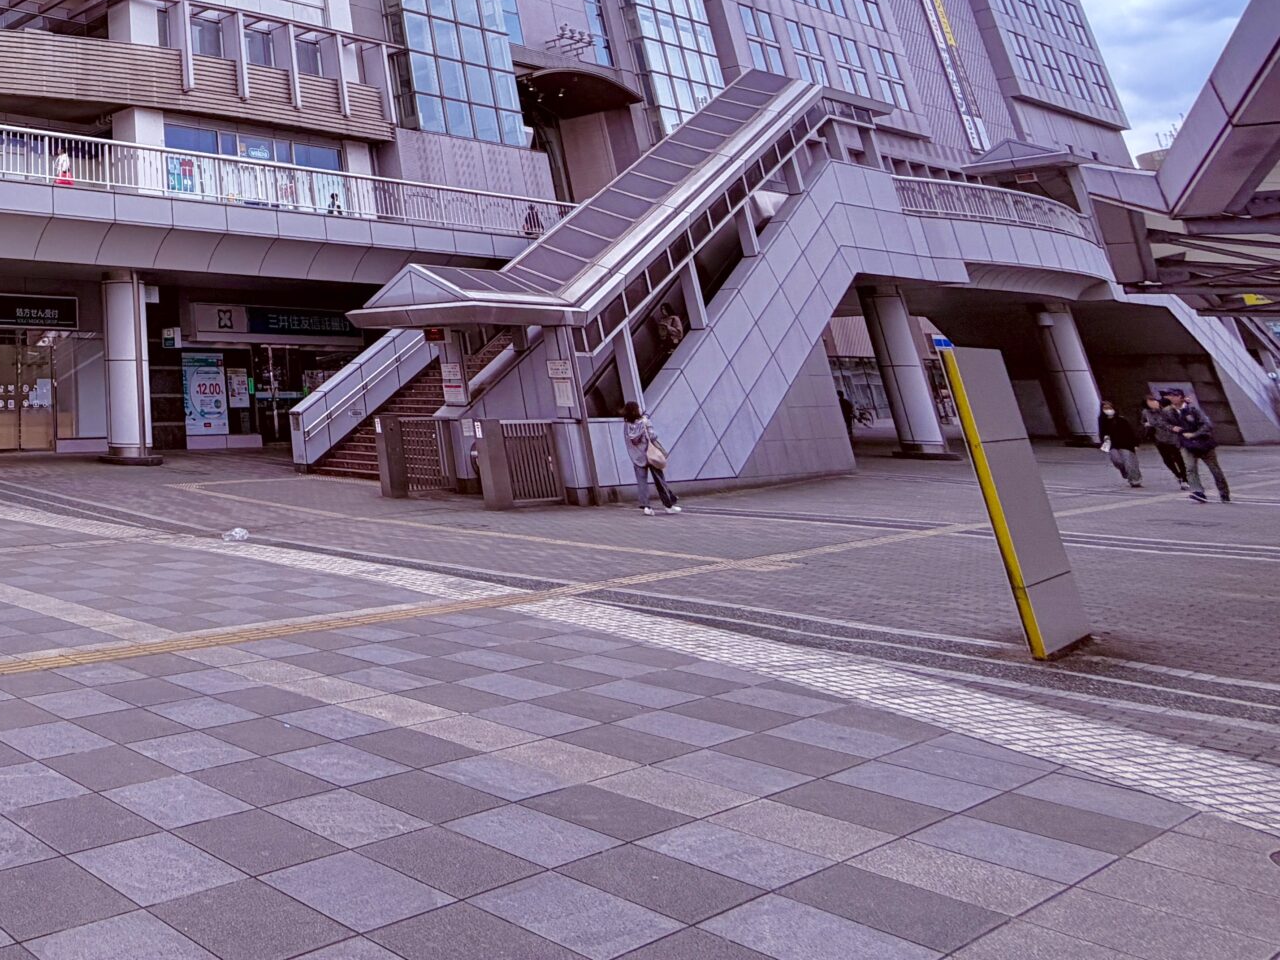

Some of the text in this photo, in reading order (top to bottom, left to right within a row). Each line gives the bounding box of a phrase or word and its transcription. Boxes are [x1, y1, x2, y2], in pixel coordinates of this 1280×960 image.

[15, 307, 59, 319] 処方せん受付
[267, 313, 351, 332] 三井住友信託銀行
